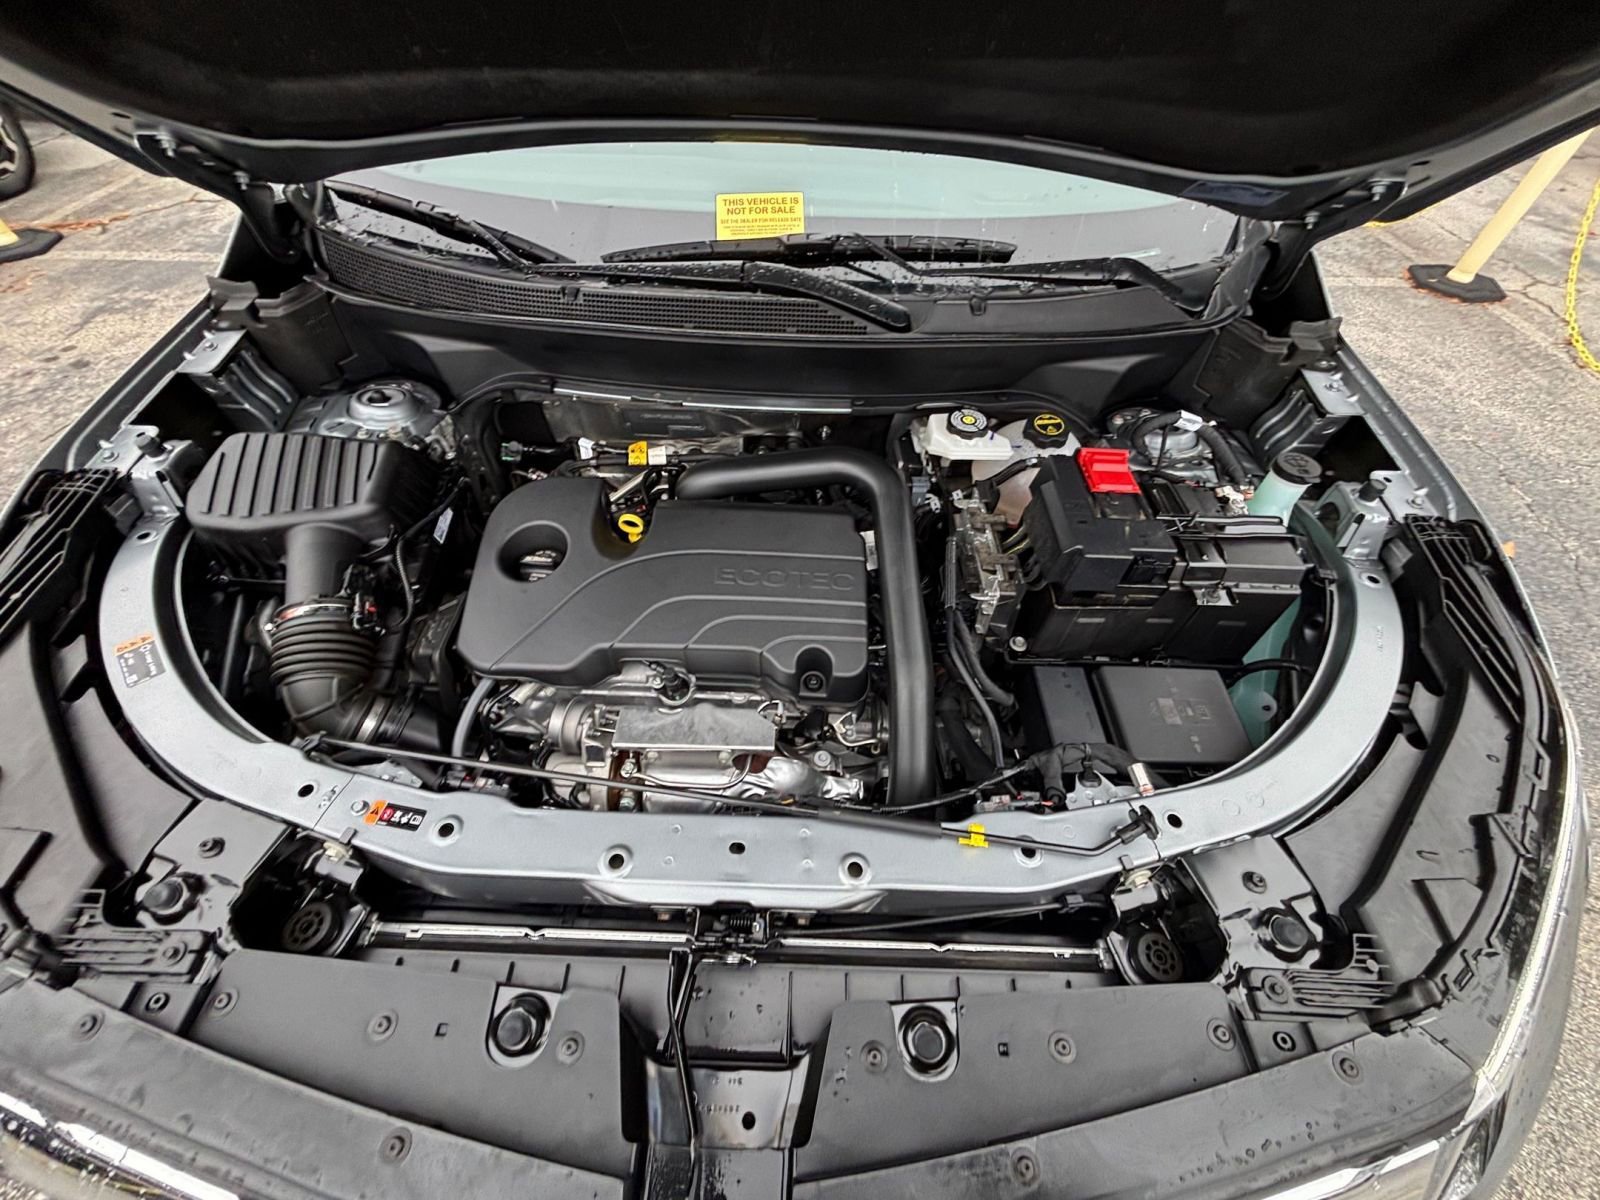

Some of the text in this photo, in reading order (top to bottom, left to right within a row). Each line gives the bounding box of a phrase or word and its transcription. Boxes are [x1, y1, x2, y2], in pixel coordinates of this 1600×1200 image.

[723, 197, 799, 206] THIS VEHICLE IS
[726, 206, 796, 215] NOT FOR SALE
[714, 567, 855, 591] ECOTEC
